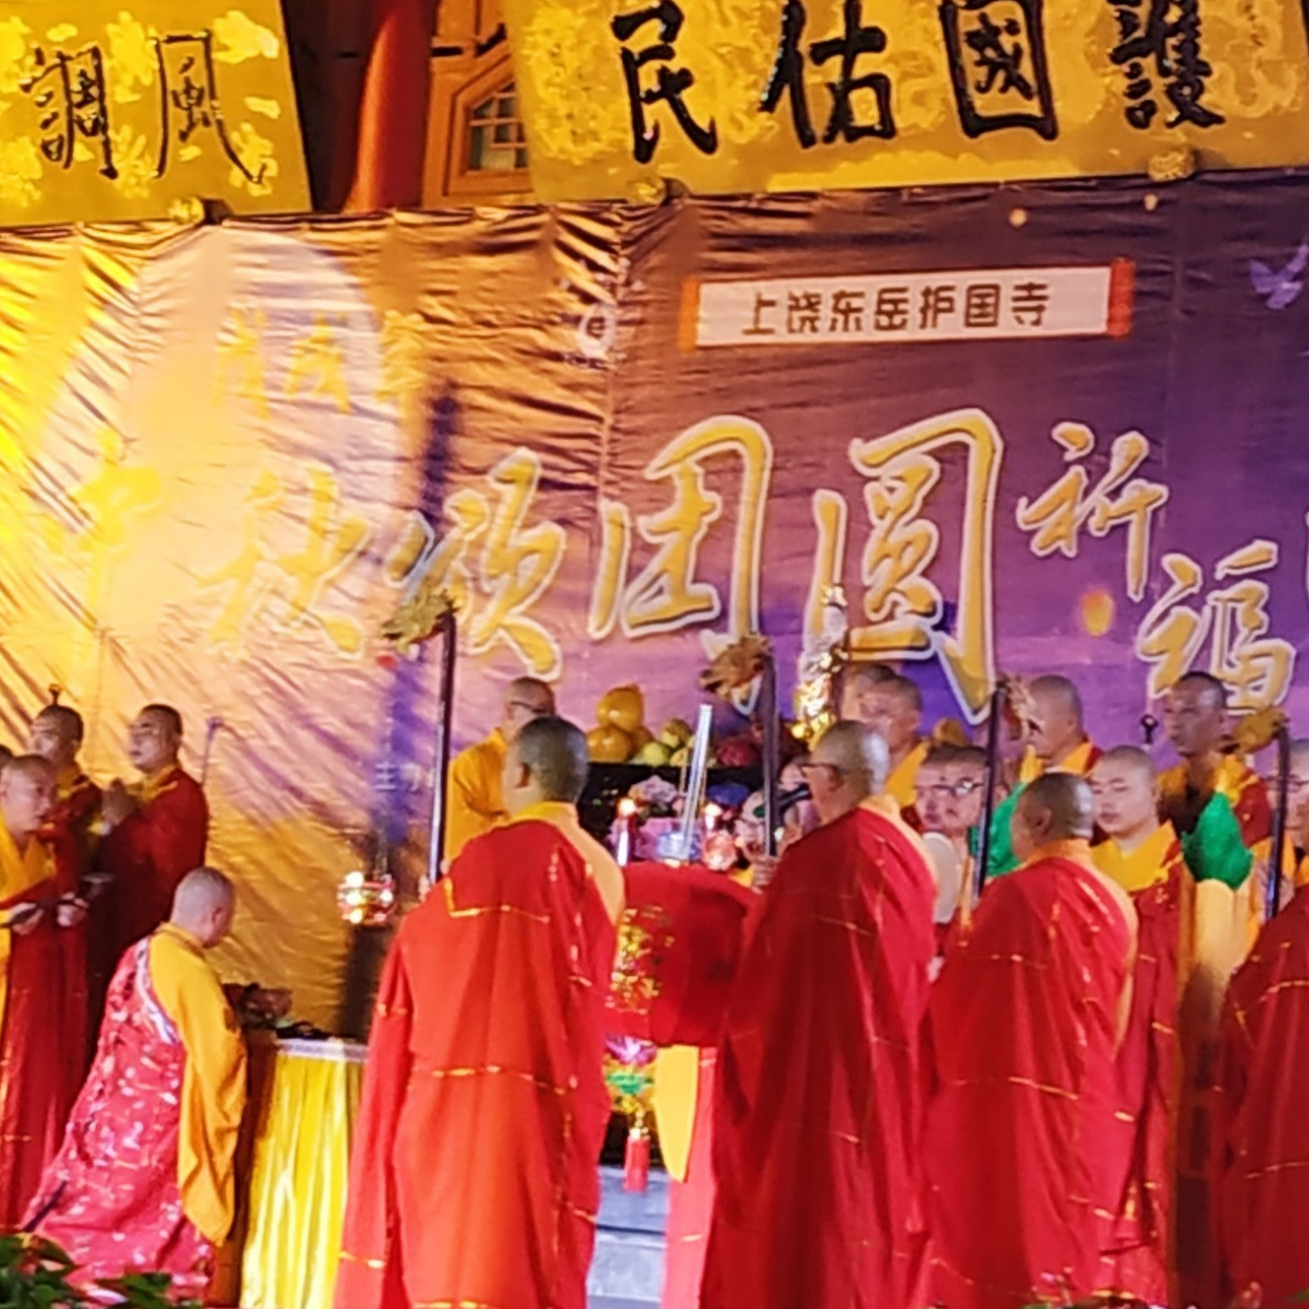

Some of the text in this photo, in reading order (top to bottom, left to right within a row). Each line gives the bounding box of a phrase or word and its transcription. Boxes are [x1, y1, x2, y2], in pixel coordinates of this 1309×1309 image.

[741, 282, 1052, 338] 上饶东岳护国寺
